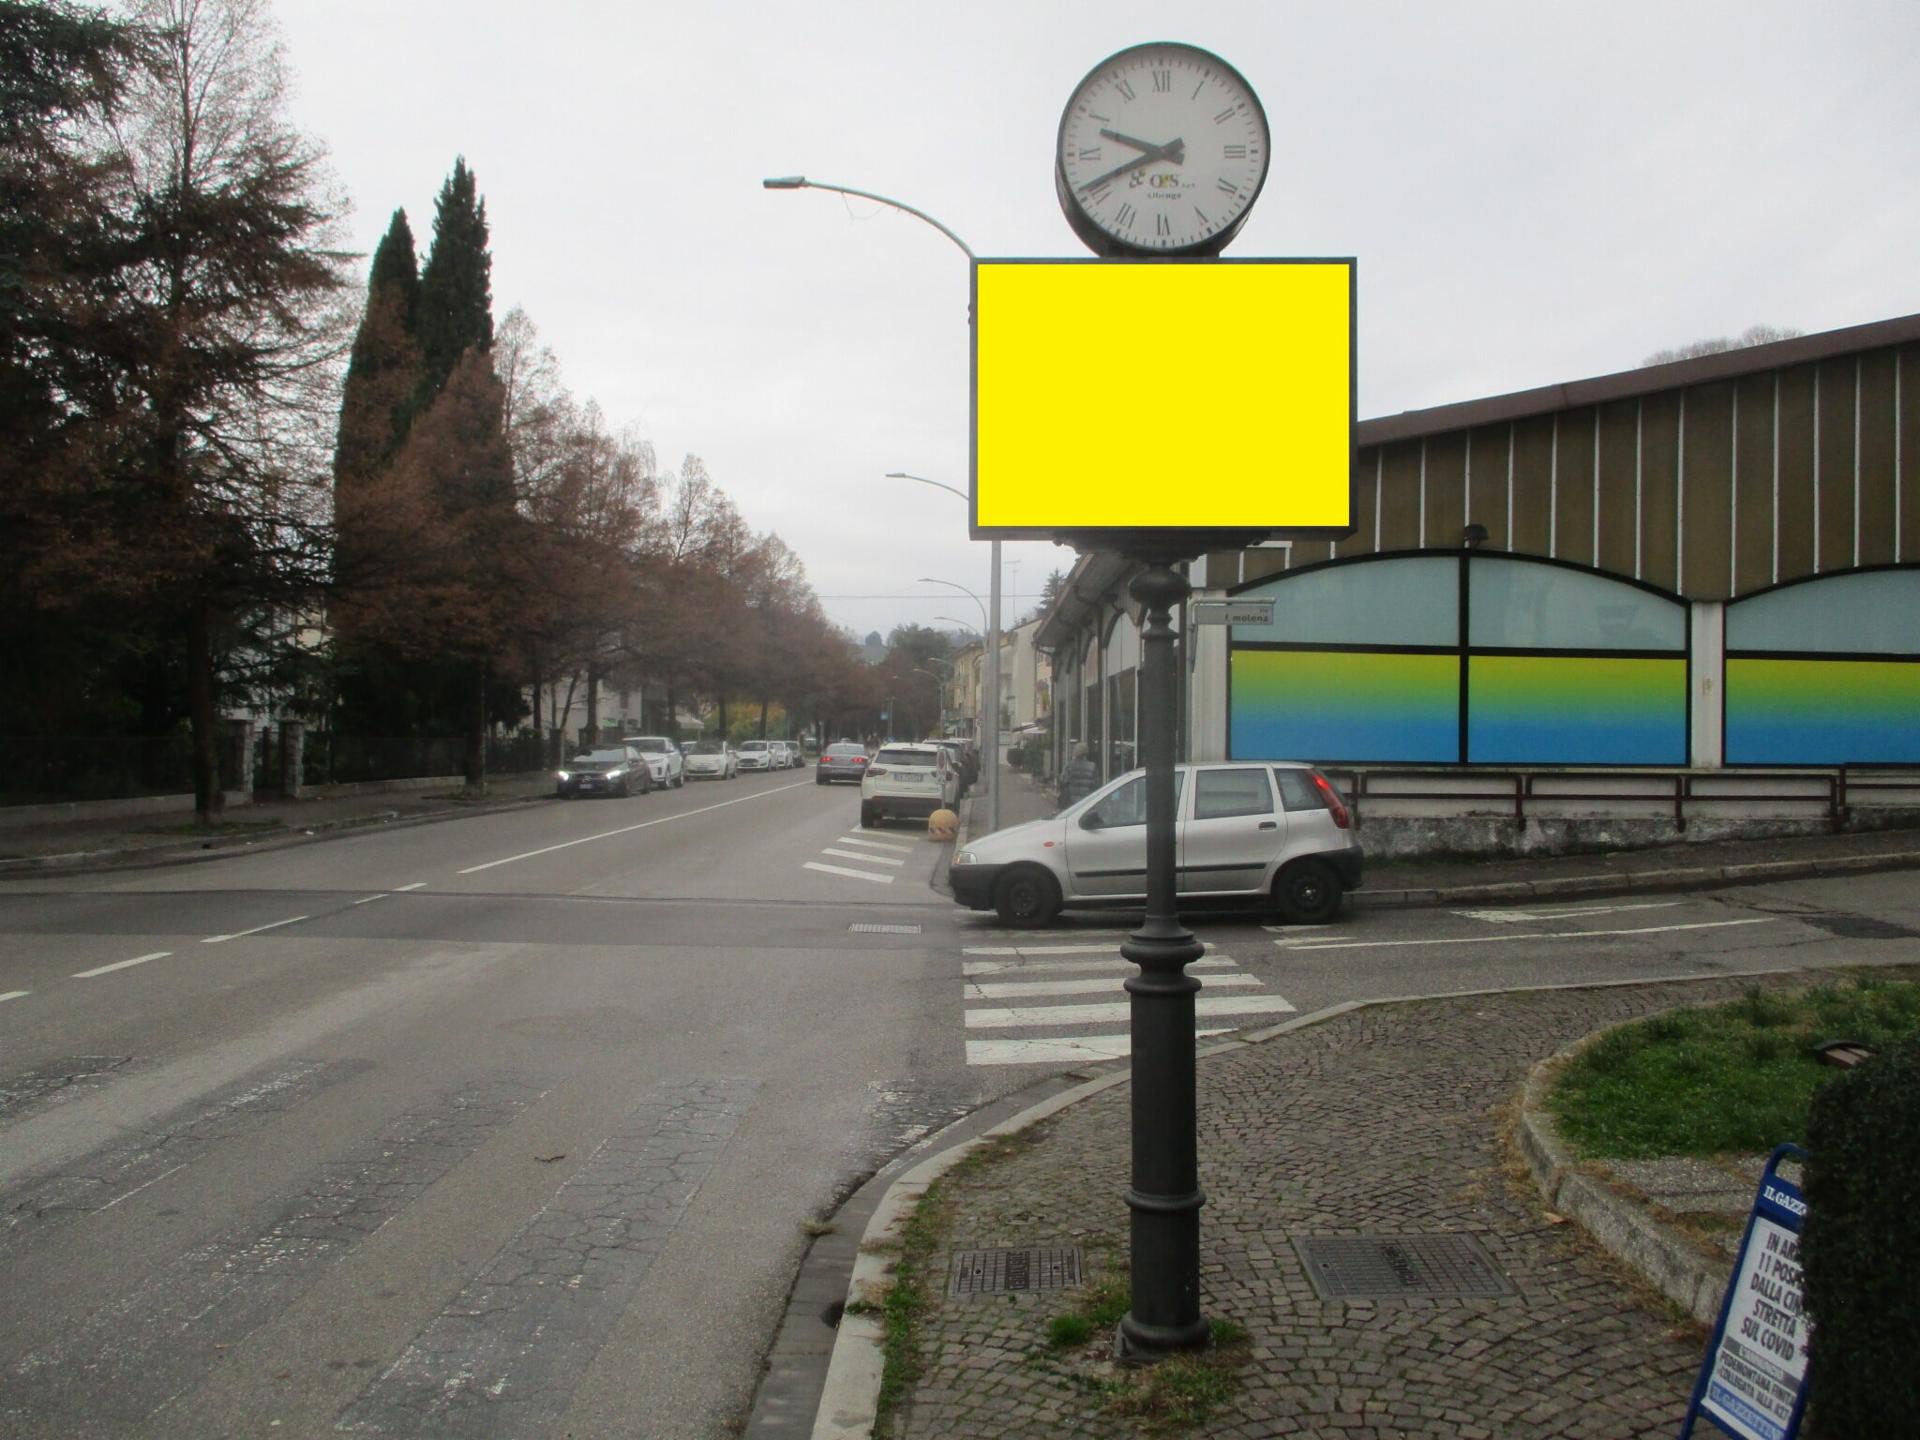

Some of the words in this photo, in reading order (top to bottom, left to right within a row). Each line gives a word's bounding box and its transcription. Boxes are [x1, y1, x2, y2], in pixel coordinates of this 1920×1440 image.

[1152, 70, 1171, 93] XII
[1213, 107, 1236, 125] II
[1223, 144, 1247, 159] III
[1763, 1184, 1776, 1202] IL
[1775, 1191, 1808, 1216] GAZZ
[1758, 1251, 1771, 1273] 11
[1766, 1231, 1780, 1254] IN
[1780, 1239, 1799, 1262] AR
[1749, 1271, 1782, 1305] DALLA
[1752, 1298, 1796, 1338] STRETTA
[1740, 1316, 1760, 1342] SUL
[1760, 1328, 1795, 1361] COVID
